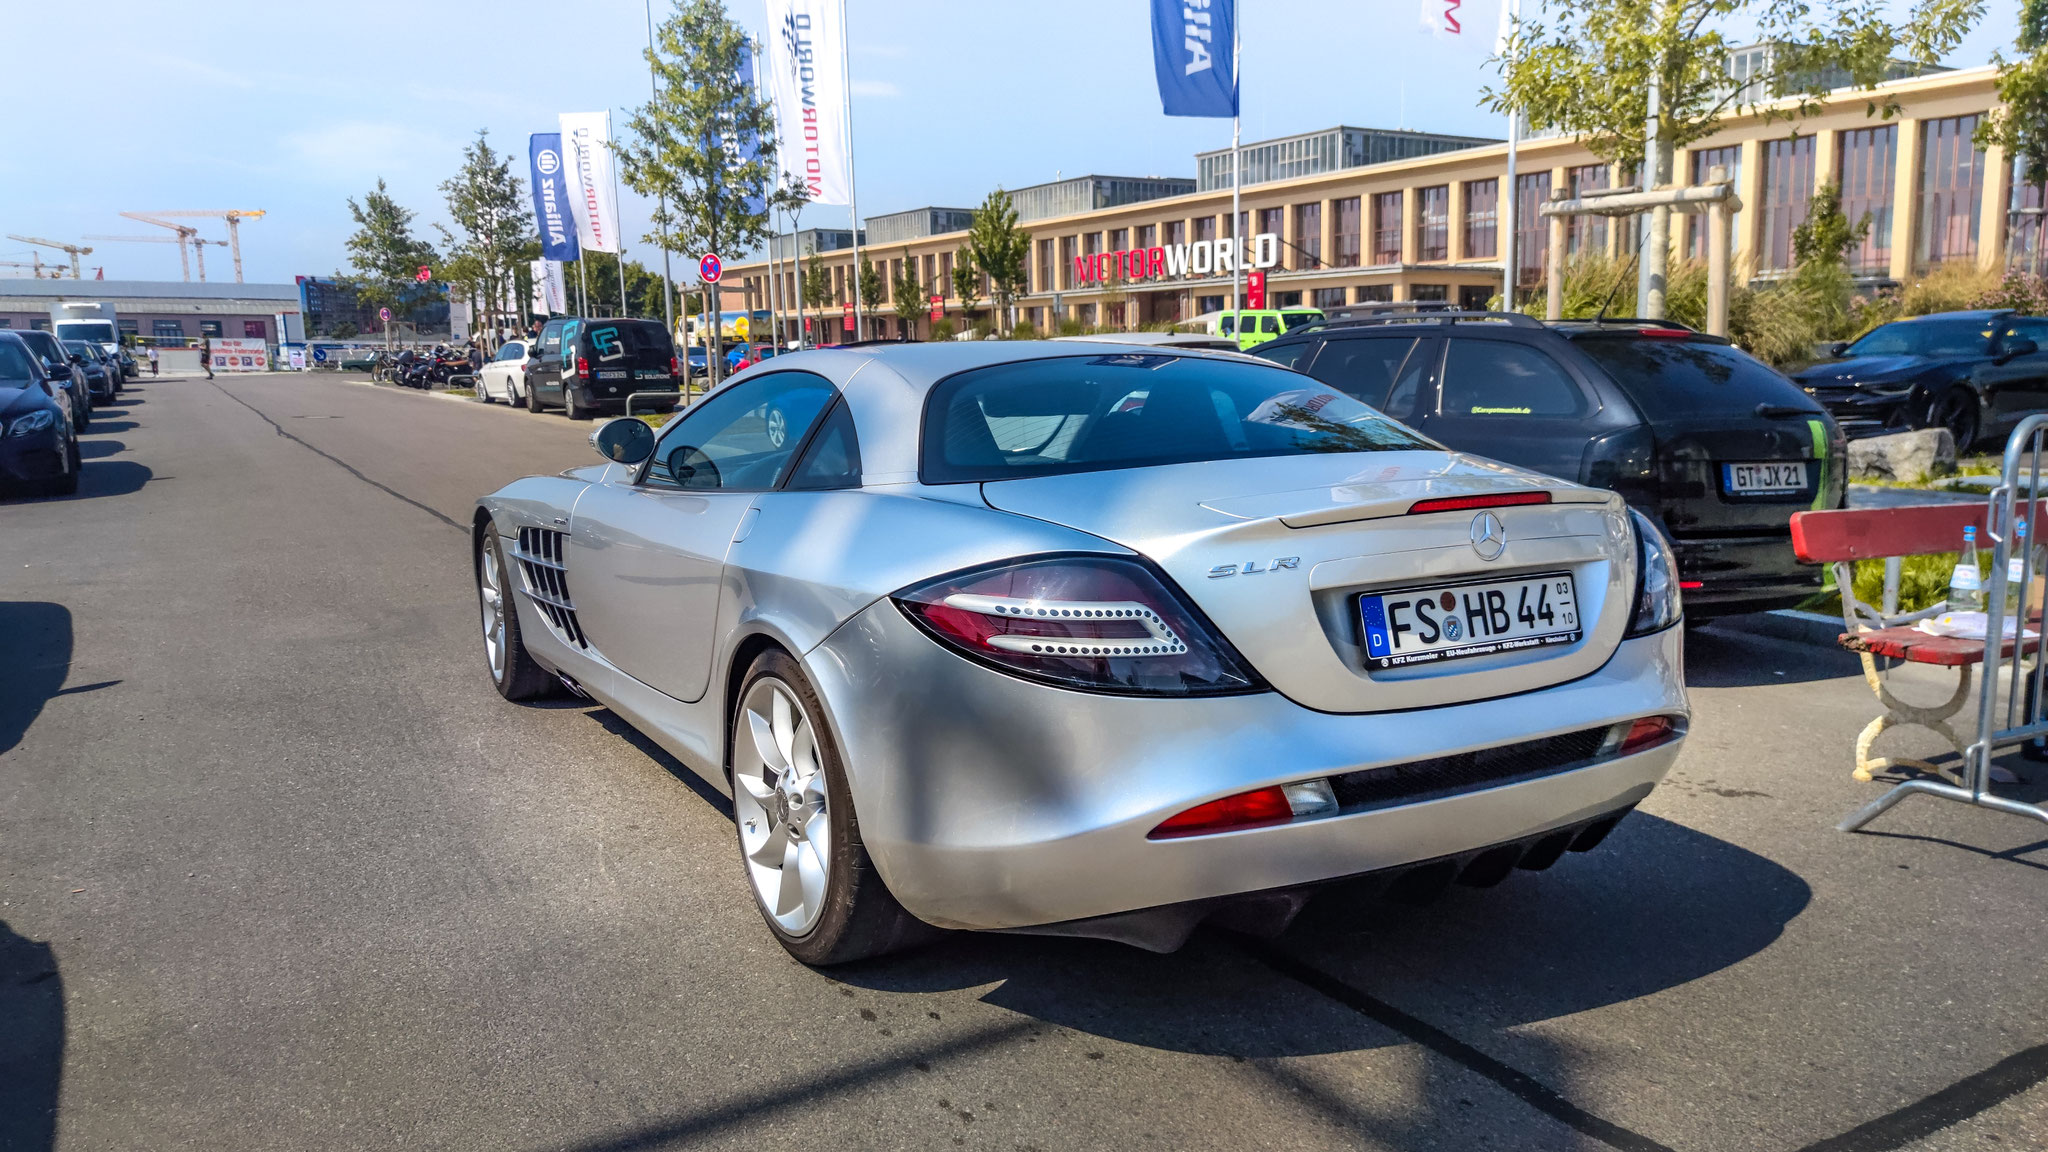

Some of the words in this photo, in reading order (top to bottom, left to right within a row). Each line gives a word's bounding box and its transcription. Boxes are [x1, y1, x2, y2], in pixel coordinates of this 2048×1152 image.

[1074, 233, 1278, 283] MOTORWORLD
[1736, 466, 1754, 487] GT
[1764, 466, 1782, 487] JX
[1783, 465, 1801, 486] 21
[1207, 556, 1300, 579] SLR
[1556, 582, 1569, 595] 03
[1388, 598, 1440, 649] FS
[1463, 590, 1511, 638] HB
[1517, 584, 1554, 629] 44
[1562, 612, 1574, 625] 10
[1373, 634, 1382, 647] D
[1392, 656, 1406, 665] KFZ
